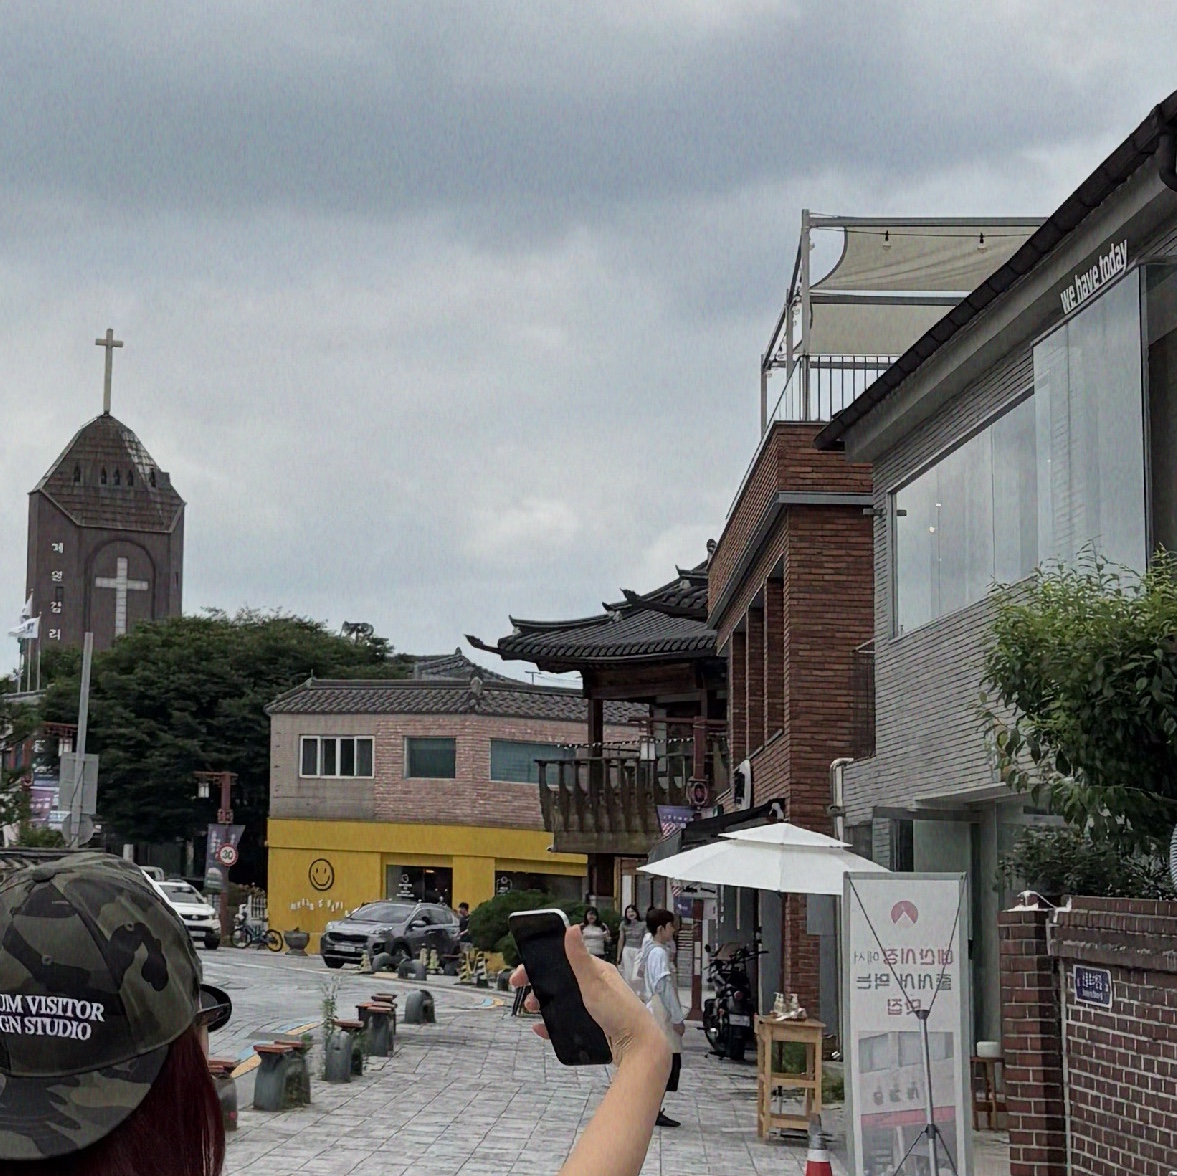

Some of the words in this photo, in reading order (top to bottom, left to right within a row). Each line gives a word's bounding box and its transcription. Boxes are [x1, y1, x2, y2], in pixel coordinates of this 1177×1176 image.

[1060, 285, 1078, 315] we
[1075, 265, 1099, 303] have
[1099, 239, 1127, 283] today
[221, 849, 233, 860] 30
[25, 995, 105, 1022] VISITOR
[25, 1016, 92, 1041] STUDIO
